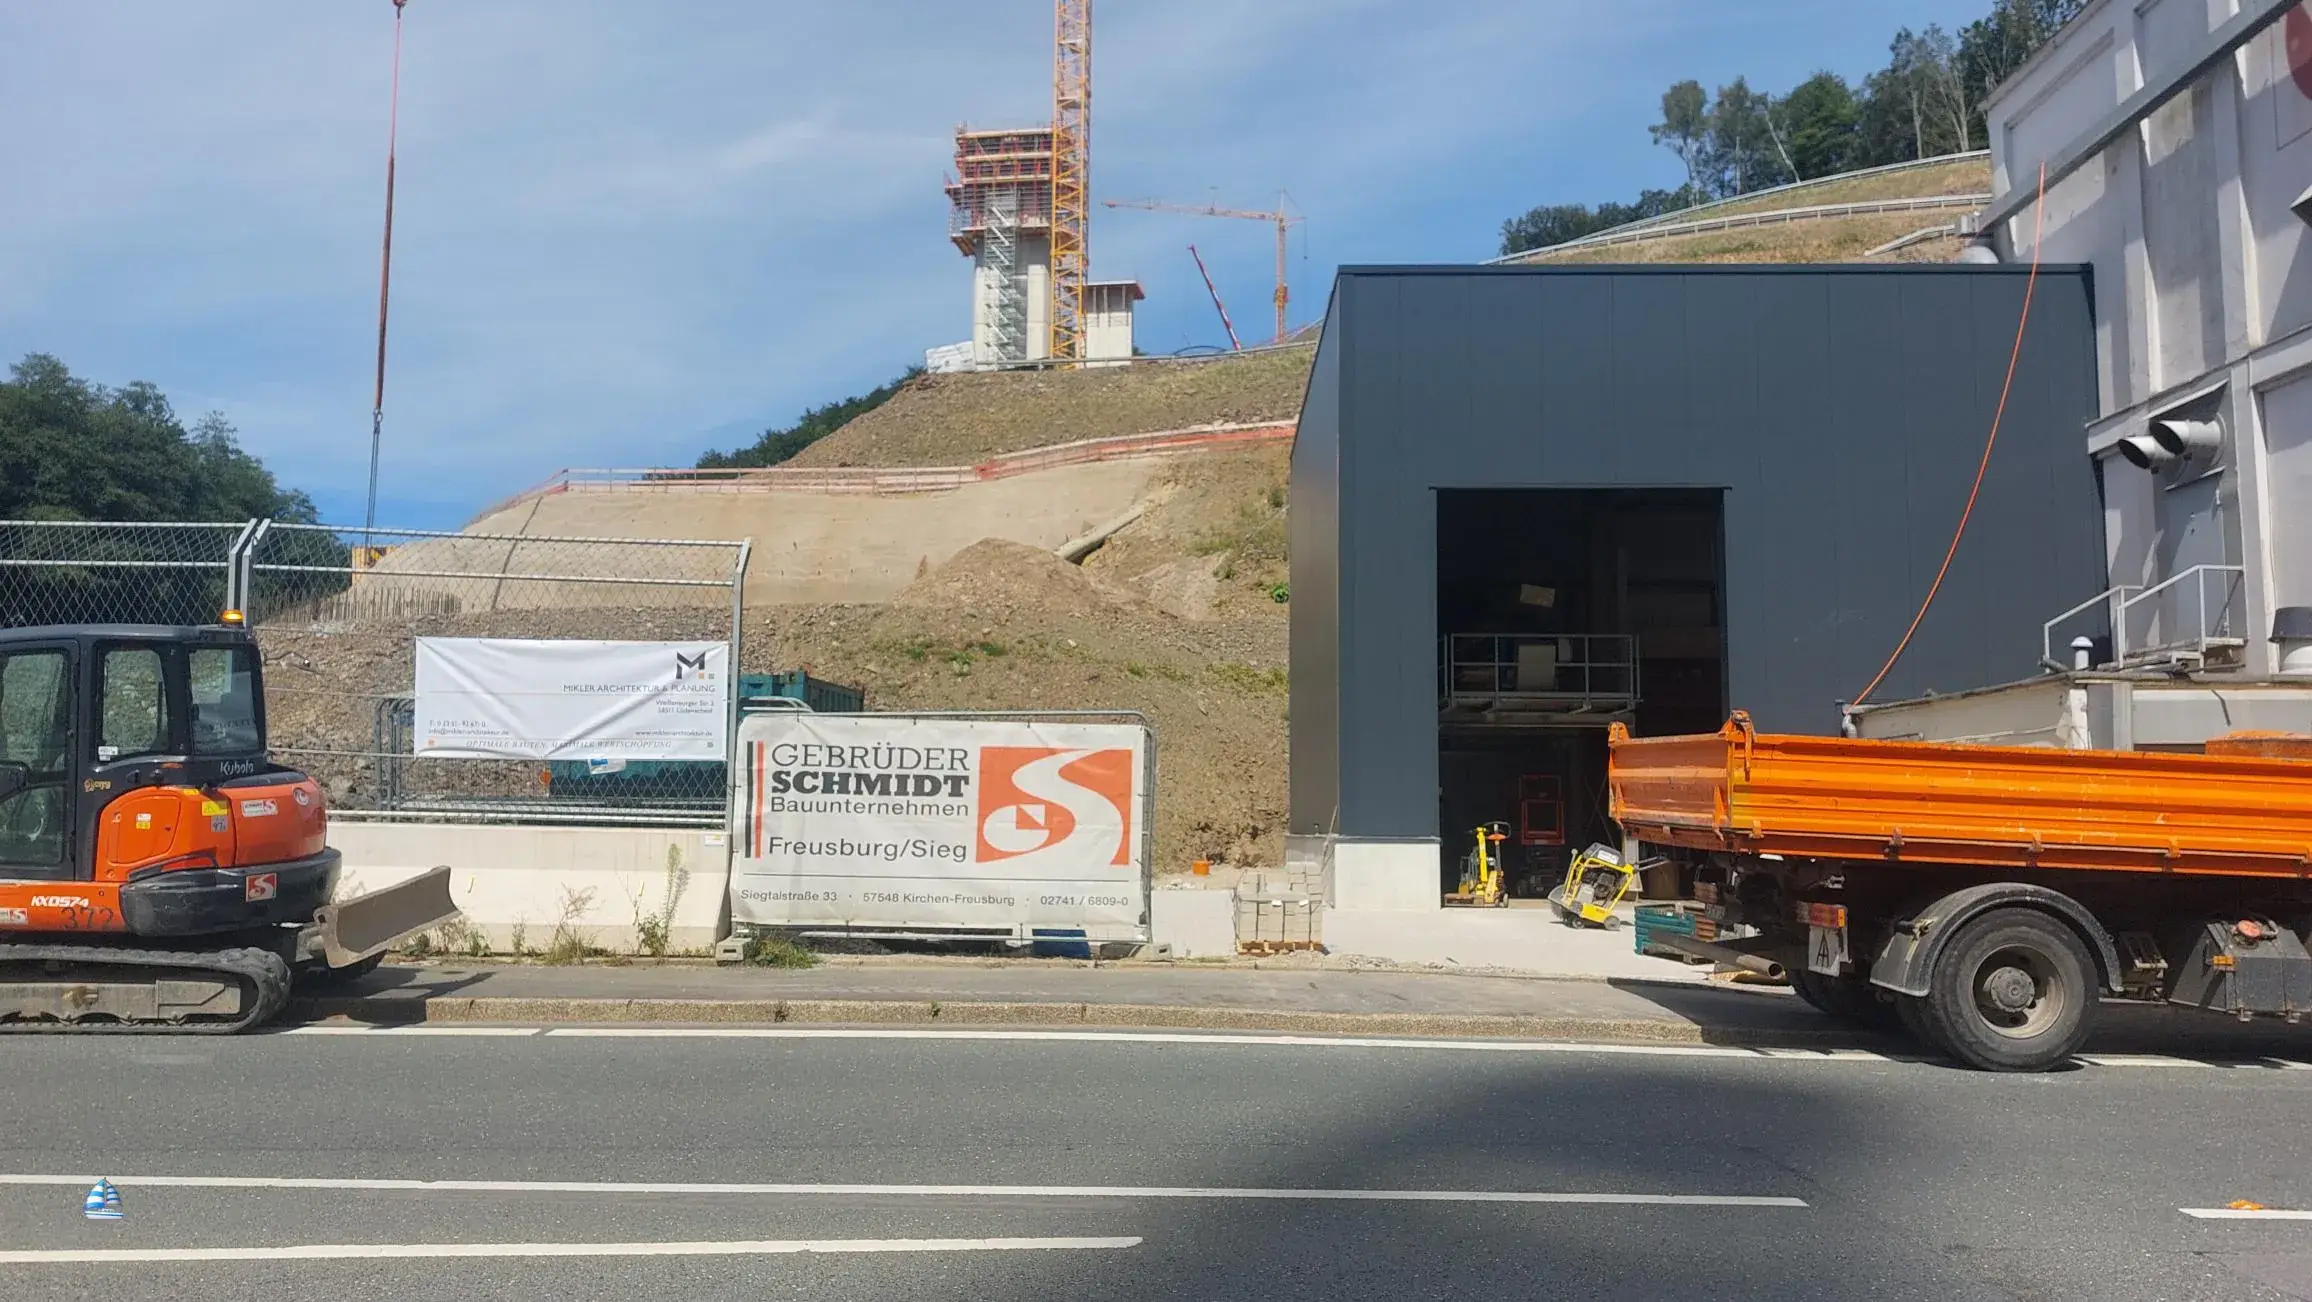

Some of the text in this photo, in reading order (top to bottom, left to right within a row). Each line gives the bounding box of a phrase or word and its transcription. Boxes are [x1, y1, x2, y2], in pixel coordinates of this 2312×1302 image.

[563, 684, 595, 692] MIKLER
[597, 684, 662, 693] ARCHITEKTUR
[671, 684, 716, 693] PLANUNG
[771, 741, 970, 771] GEBRÜDER
[771, 770, 970, 798] SCHMIDT
[770, 796, 969, 817] Bauunternehmen
[768, 836, 967, 863] Freusburg/Sieg
[740, 889, 819, 902] Siegtalstraße
[822, 891, 838, 902] 33
[863, 892, 899, 903] 57548
[903, 892, 1015, 907] Kirchen-Freusburg
[1040, 895, 1075, 906] 02741
[1088, 896, 1129, 906] 6809-0
